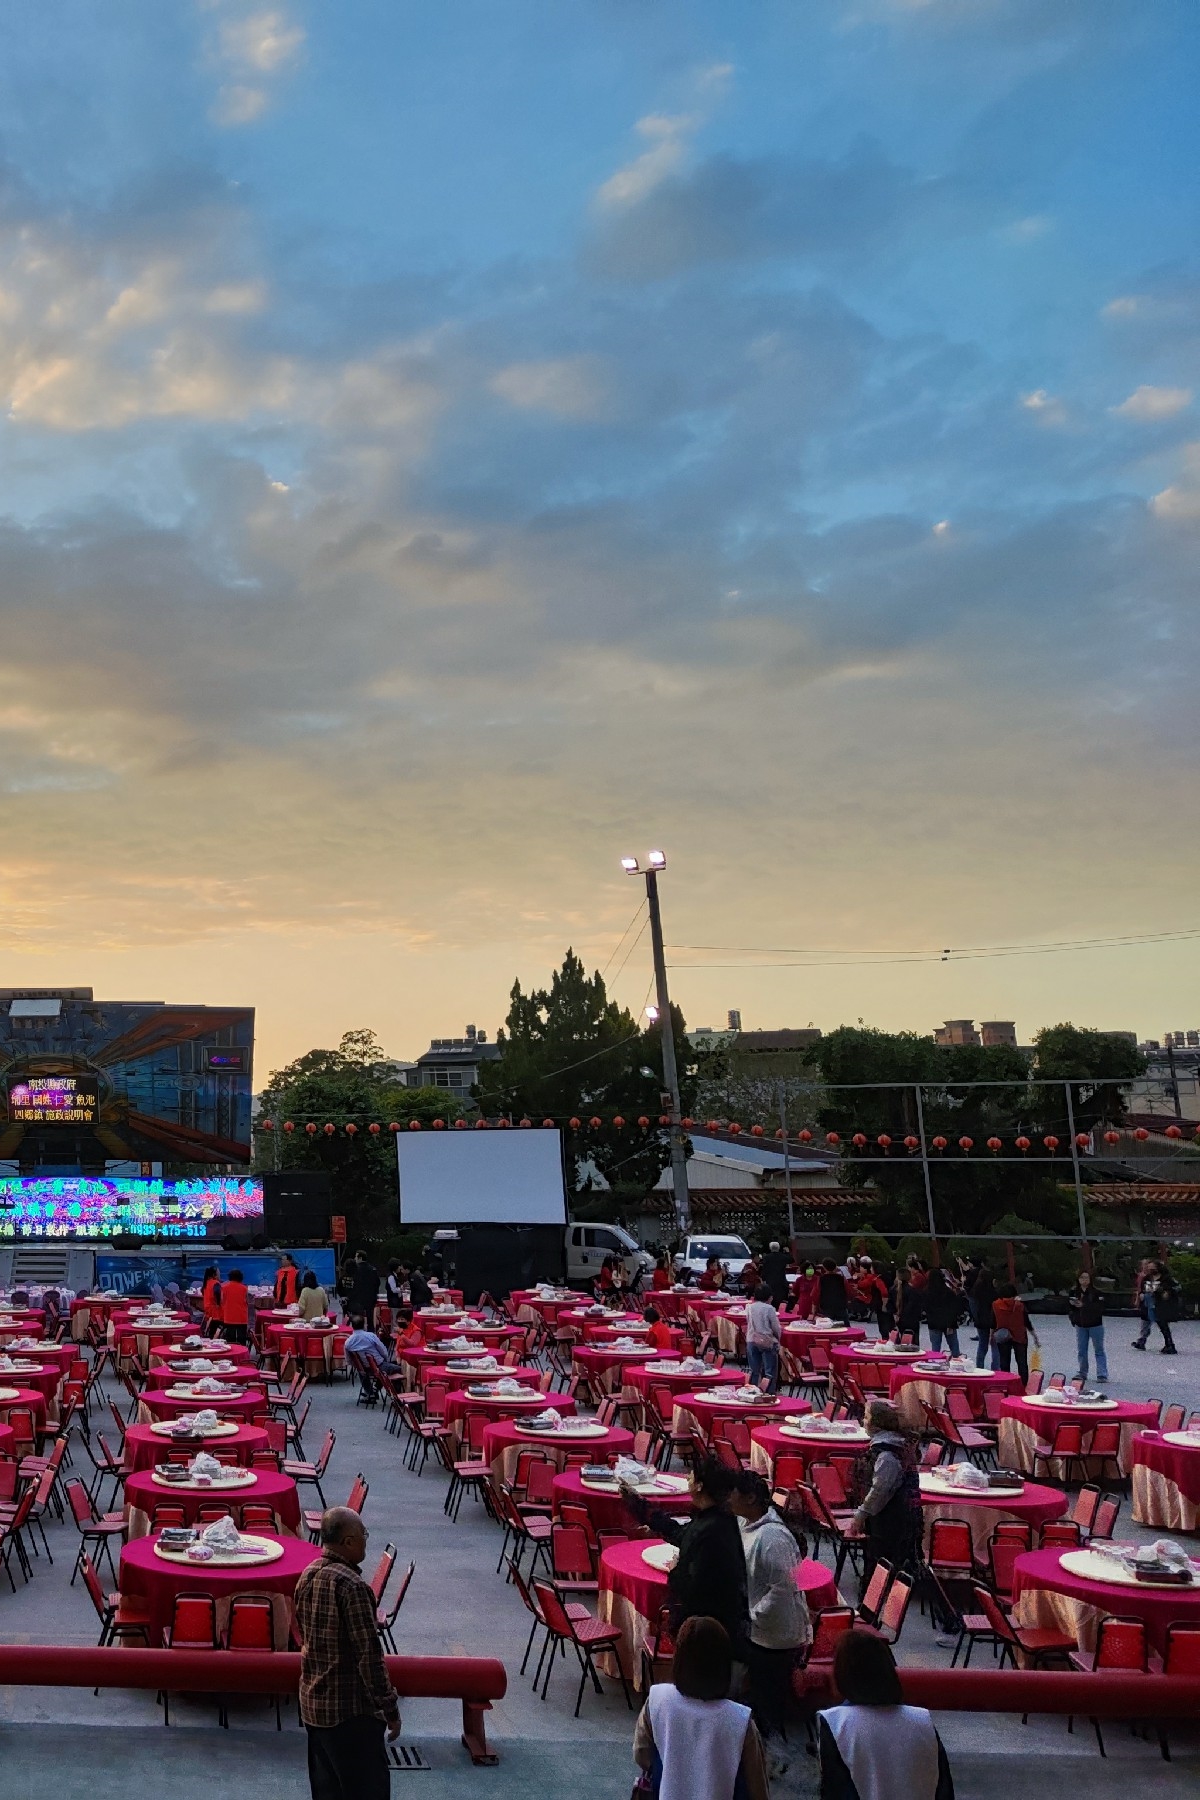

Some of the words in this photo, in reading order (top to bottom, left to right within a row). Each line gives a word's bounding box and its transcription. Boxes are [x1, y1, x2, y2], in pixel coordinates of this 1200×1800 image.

[28, 1079, 76, 1091] 南投縣政府
[11, 1094, 30, 1106] 埔里
[55, 1094, 73, 1106] 仁愛
[76, 1094, 95, 1106] 魚池
[14, 1109, 43, 1121] 四鄉鎮
[46, 1109, 93, 1121] 施政說明會
